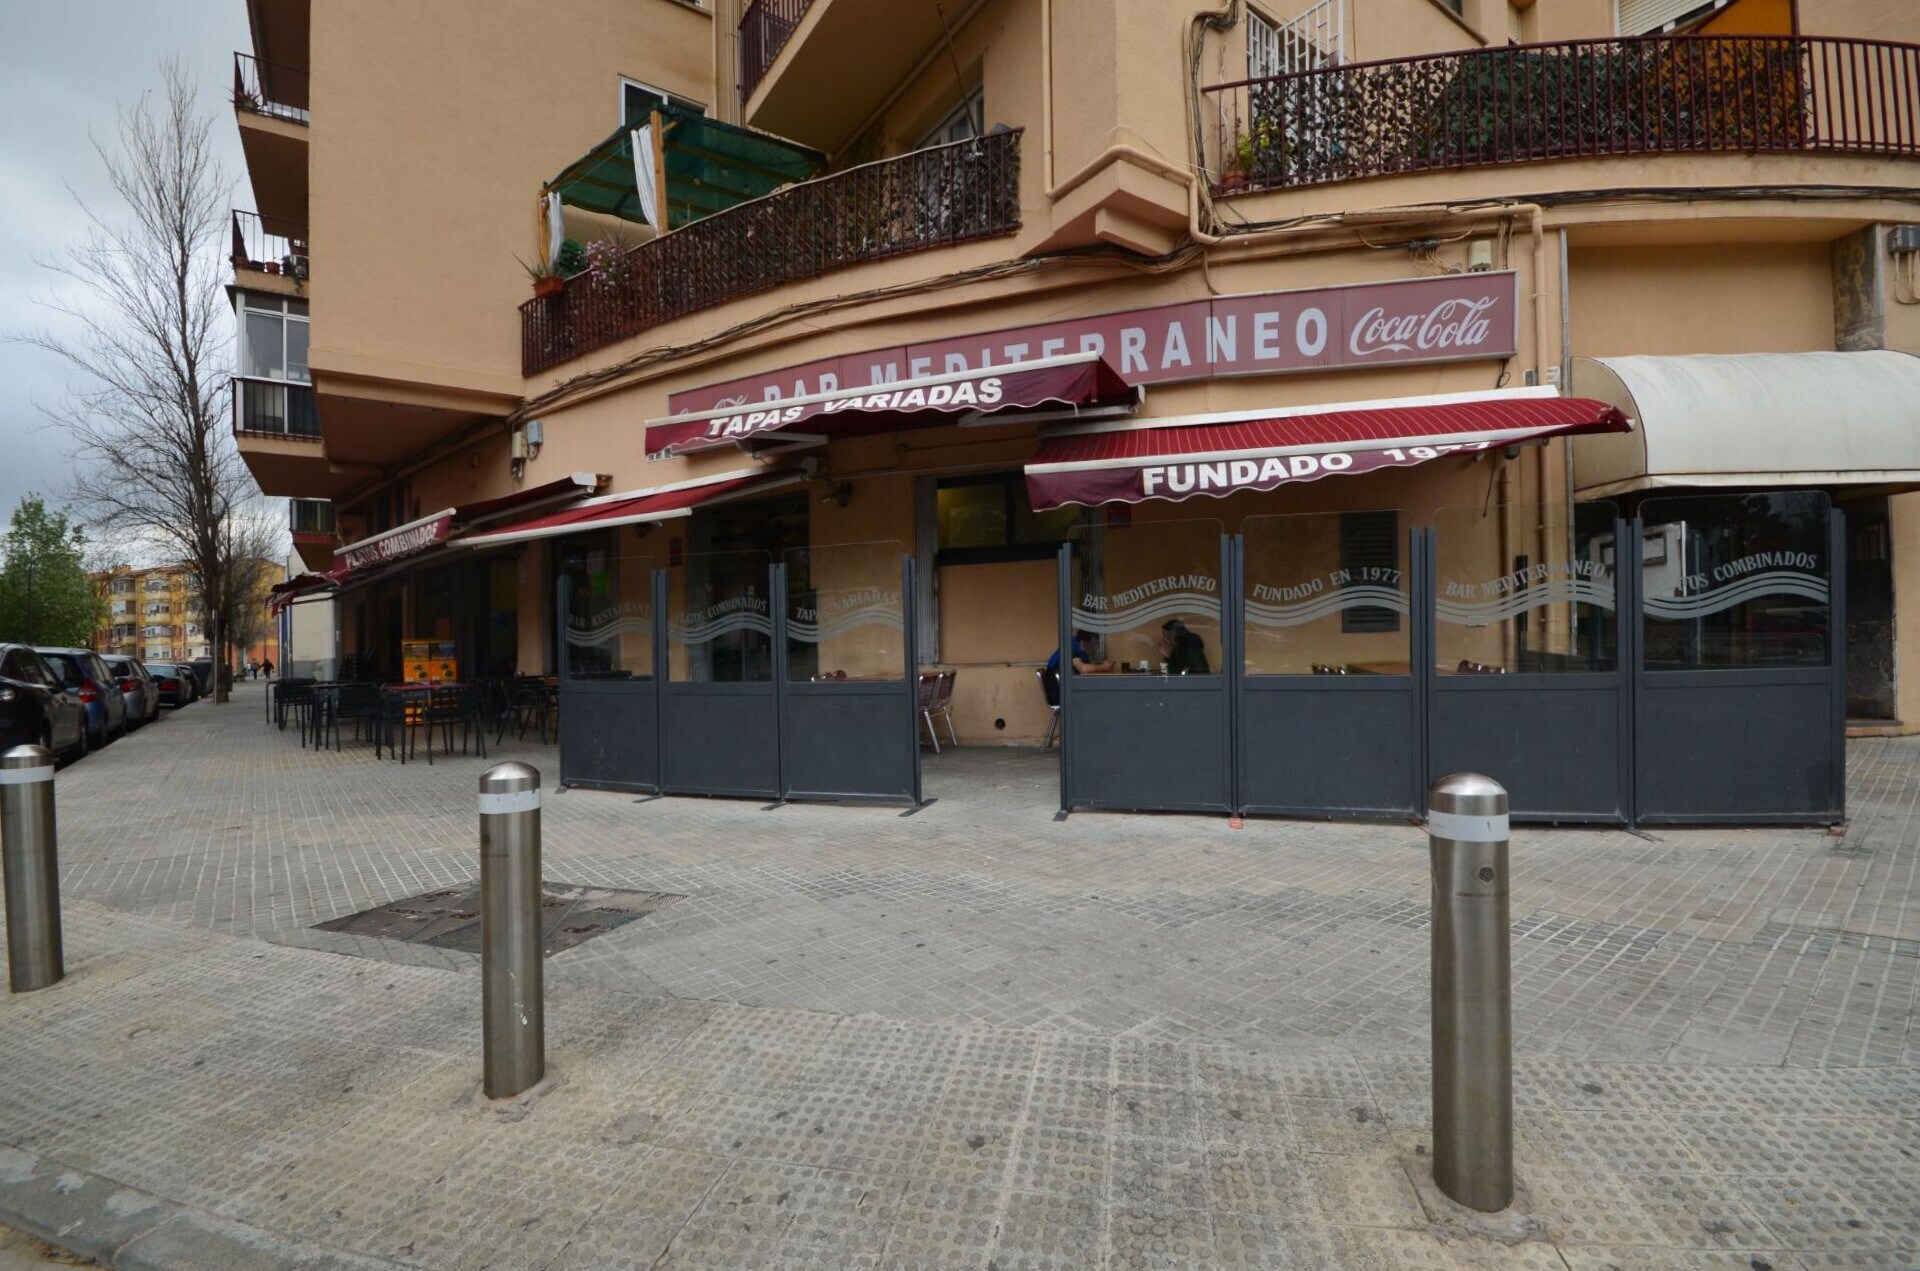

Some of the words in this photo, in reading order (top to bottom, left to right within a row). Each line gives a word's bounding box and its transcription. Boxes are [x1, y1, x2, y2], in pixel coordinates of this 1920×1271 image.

[1350, 295, 1499, 356] Coca-Cola
[708, 406, 804, 437] TAPAS
[824, 377, 1003, 412] VARIADAS
[1143, 452, 1353, 495] FUNDADO
[345, 545, 379, 569] PLATOS
[379, 522, 438, 558] COMBINADOS
[1253, 578, 1323, 600] FUNDADO
[1329, 568, 1351, 586] EN
[1362, 566, 1402, 583] 1977
[1713, 551, 1817, 582] COMBINADOS
[707, 596, 768, 618] COMBINADOS
[1083, 593, 1108, 610] BAR
[1111, 574, 1216, 608] MEDITERRANEO
[1446, 581, 1475, 599] BAR
